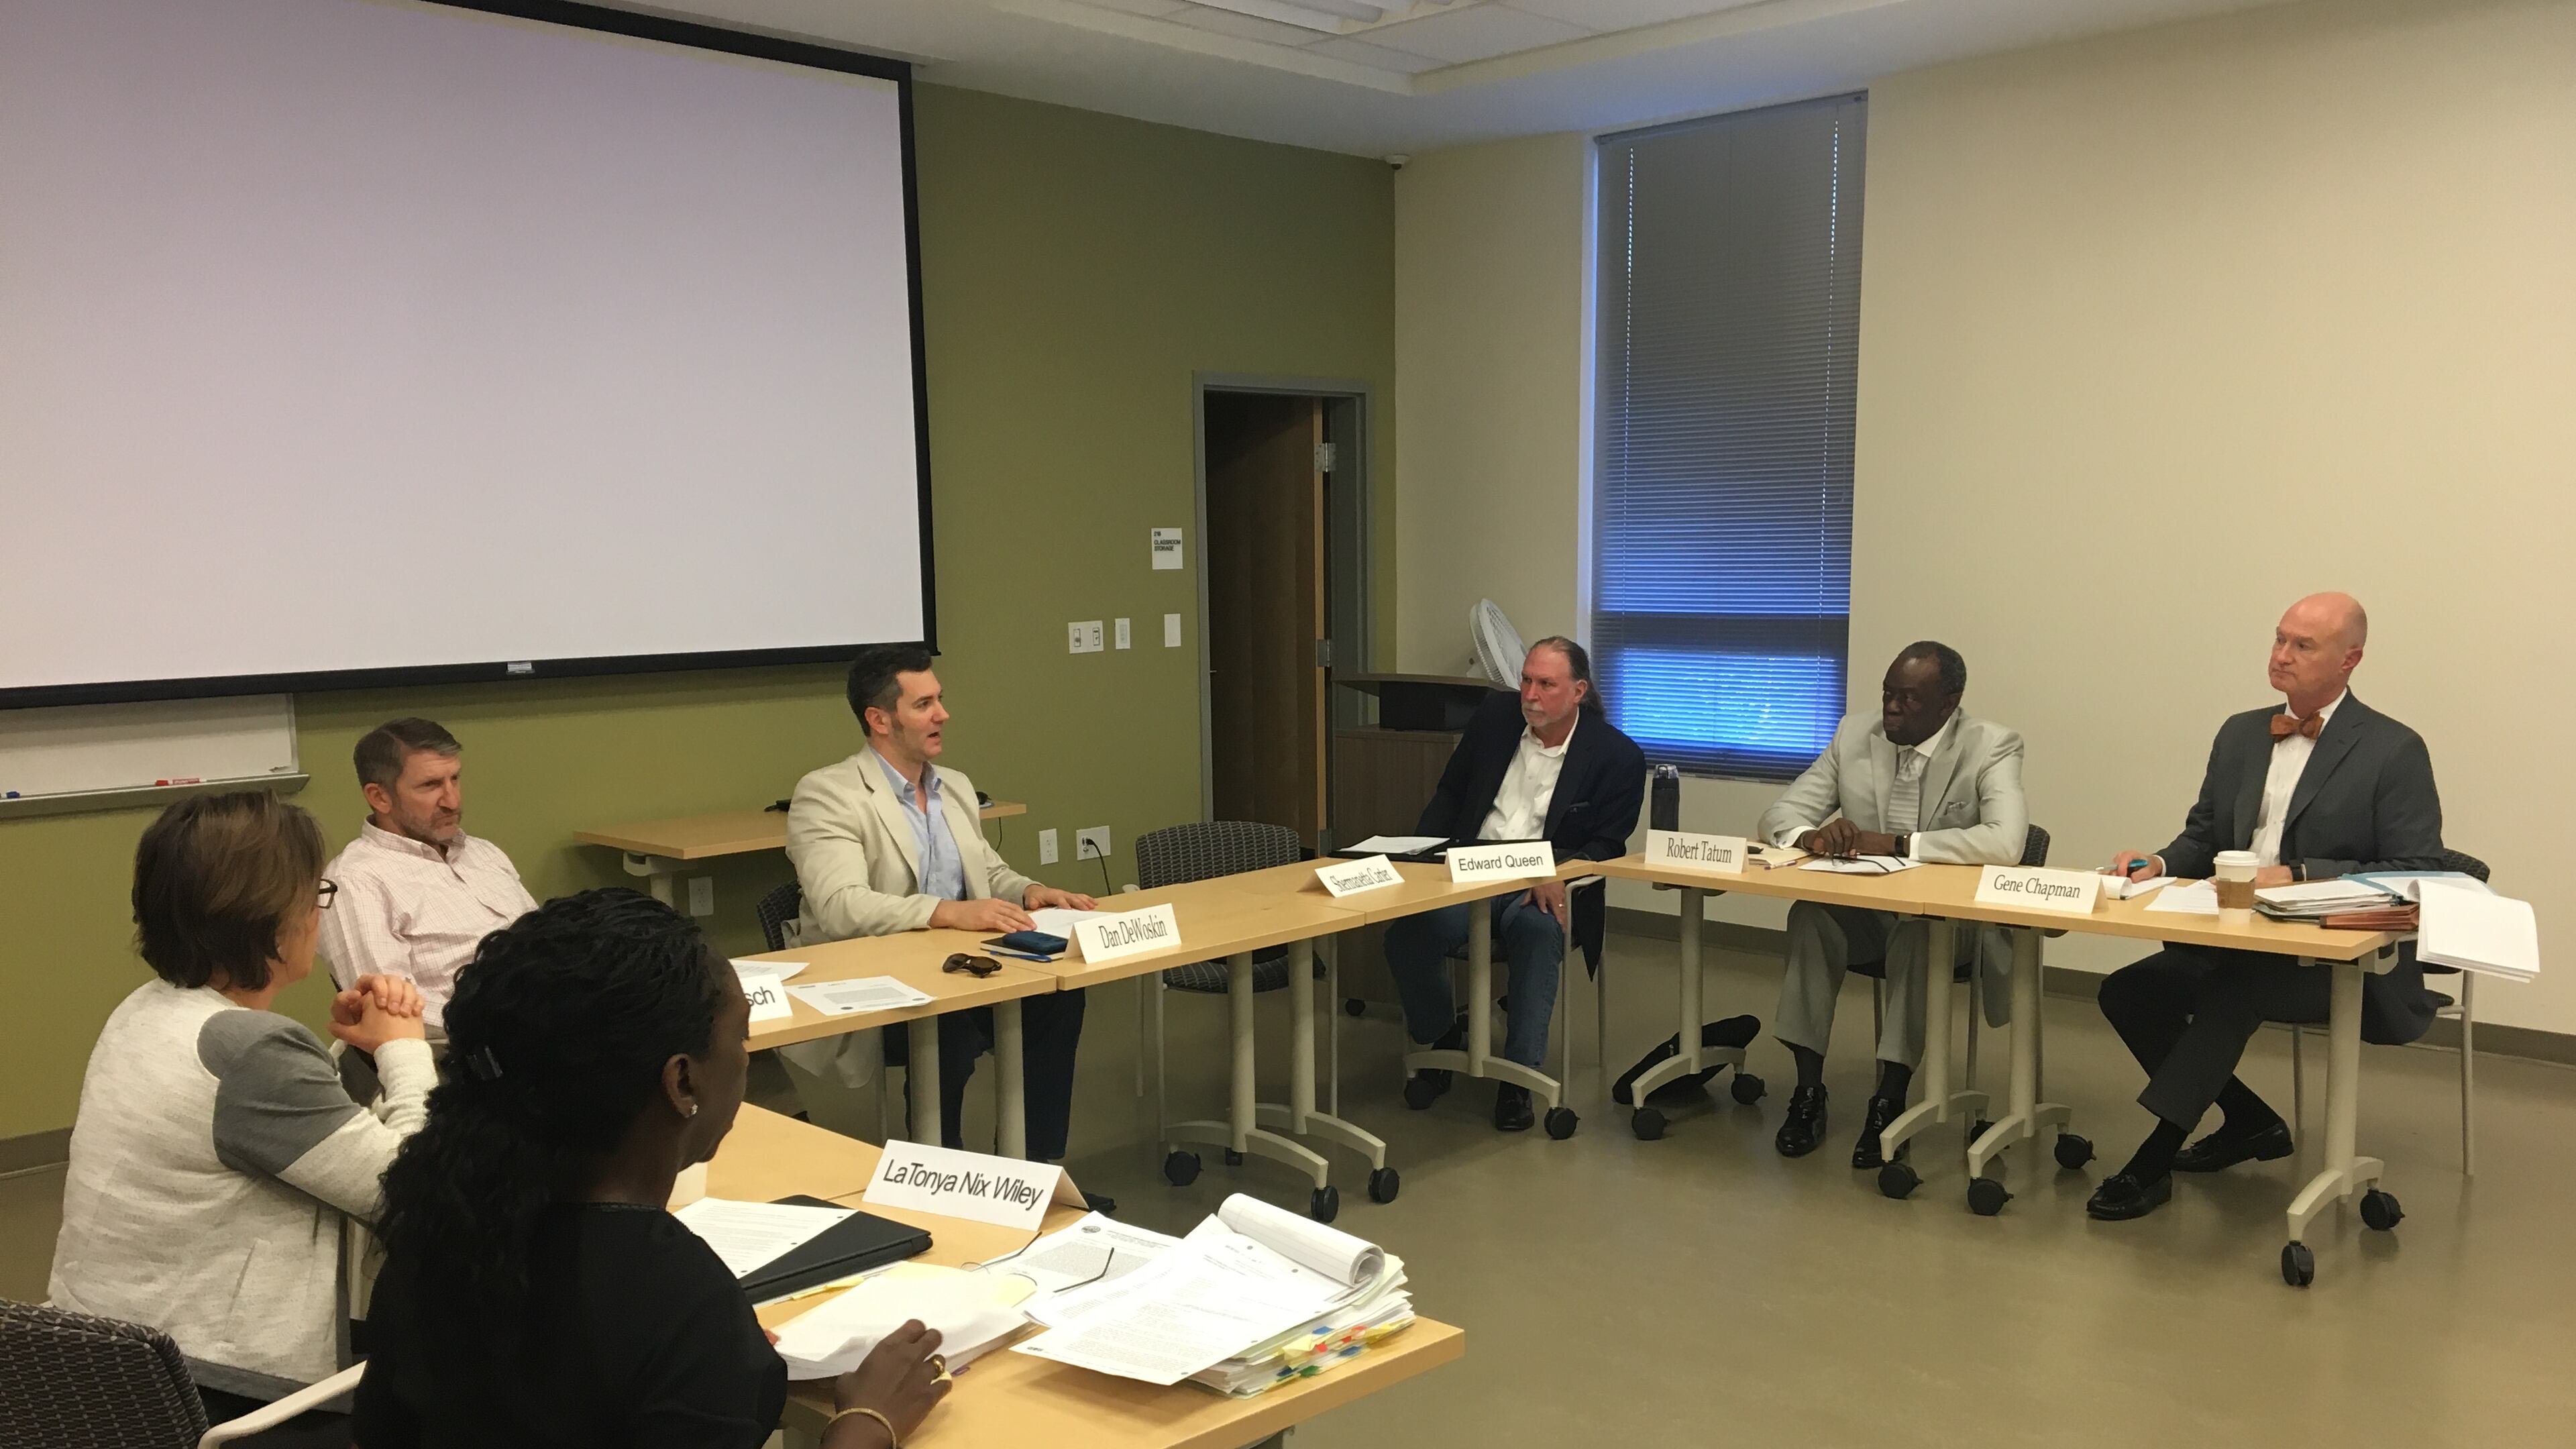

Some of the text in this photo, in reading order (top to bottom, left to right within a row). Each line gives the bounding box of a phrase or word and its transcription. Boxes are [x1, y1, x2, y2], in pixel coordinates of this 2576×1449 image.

[1458, 855, 1544, 871] Edward Queen
[1666, 837, 1732, 863] Robert Tatum
[1994, 874, 2081, 900] Gene Chapman
[1098, 914, 1168, 948] Dan DeWoskin
[883, 1159, 1044, 1211] LaTonya Nix Wiley
